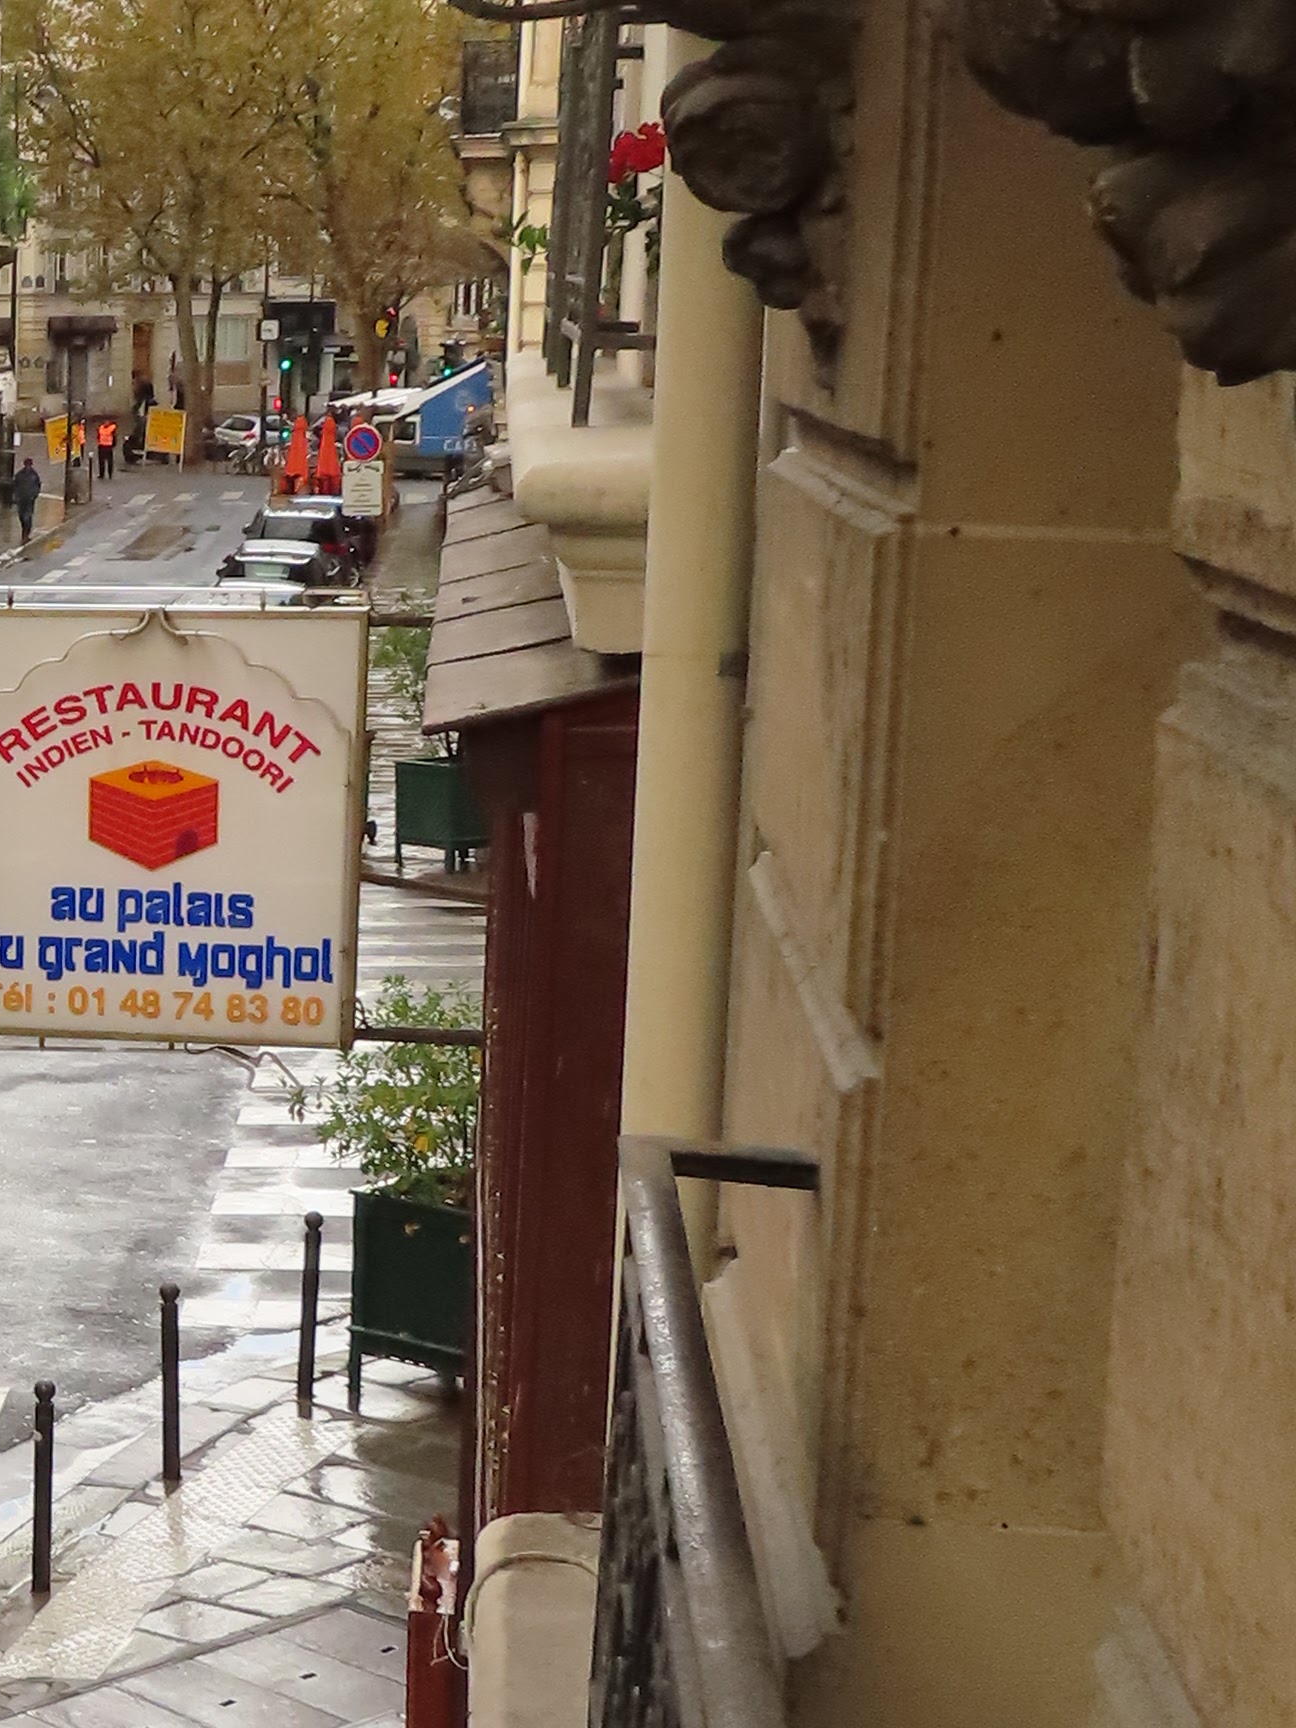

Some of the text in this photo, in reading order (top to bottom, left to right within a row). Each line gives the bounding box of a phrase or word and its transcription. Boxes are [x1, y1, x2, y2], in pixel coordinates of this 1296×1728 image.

[16, 724, 113, 788] INDIEN
[138, 719, 295, 794] TANDOORI
[51, 882, 255, 933] au palais
[38, 931, 165, 980] grand
[67, 985, 106, 1016] 01
[119, 988, 162, 1020] 48
[173, 991, 215, 1022] 74
[225, 992, 270, 1026] 83
[280, 994, 326, 1028] 80
